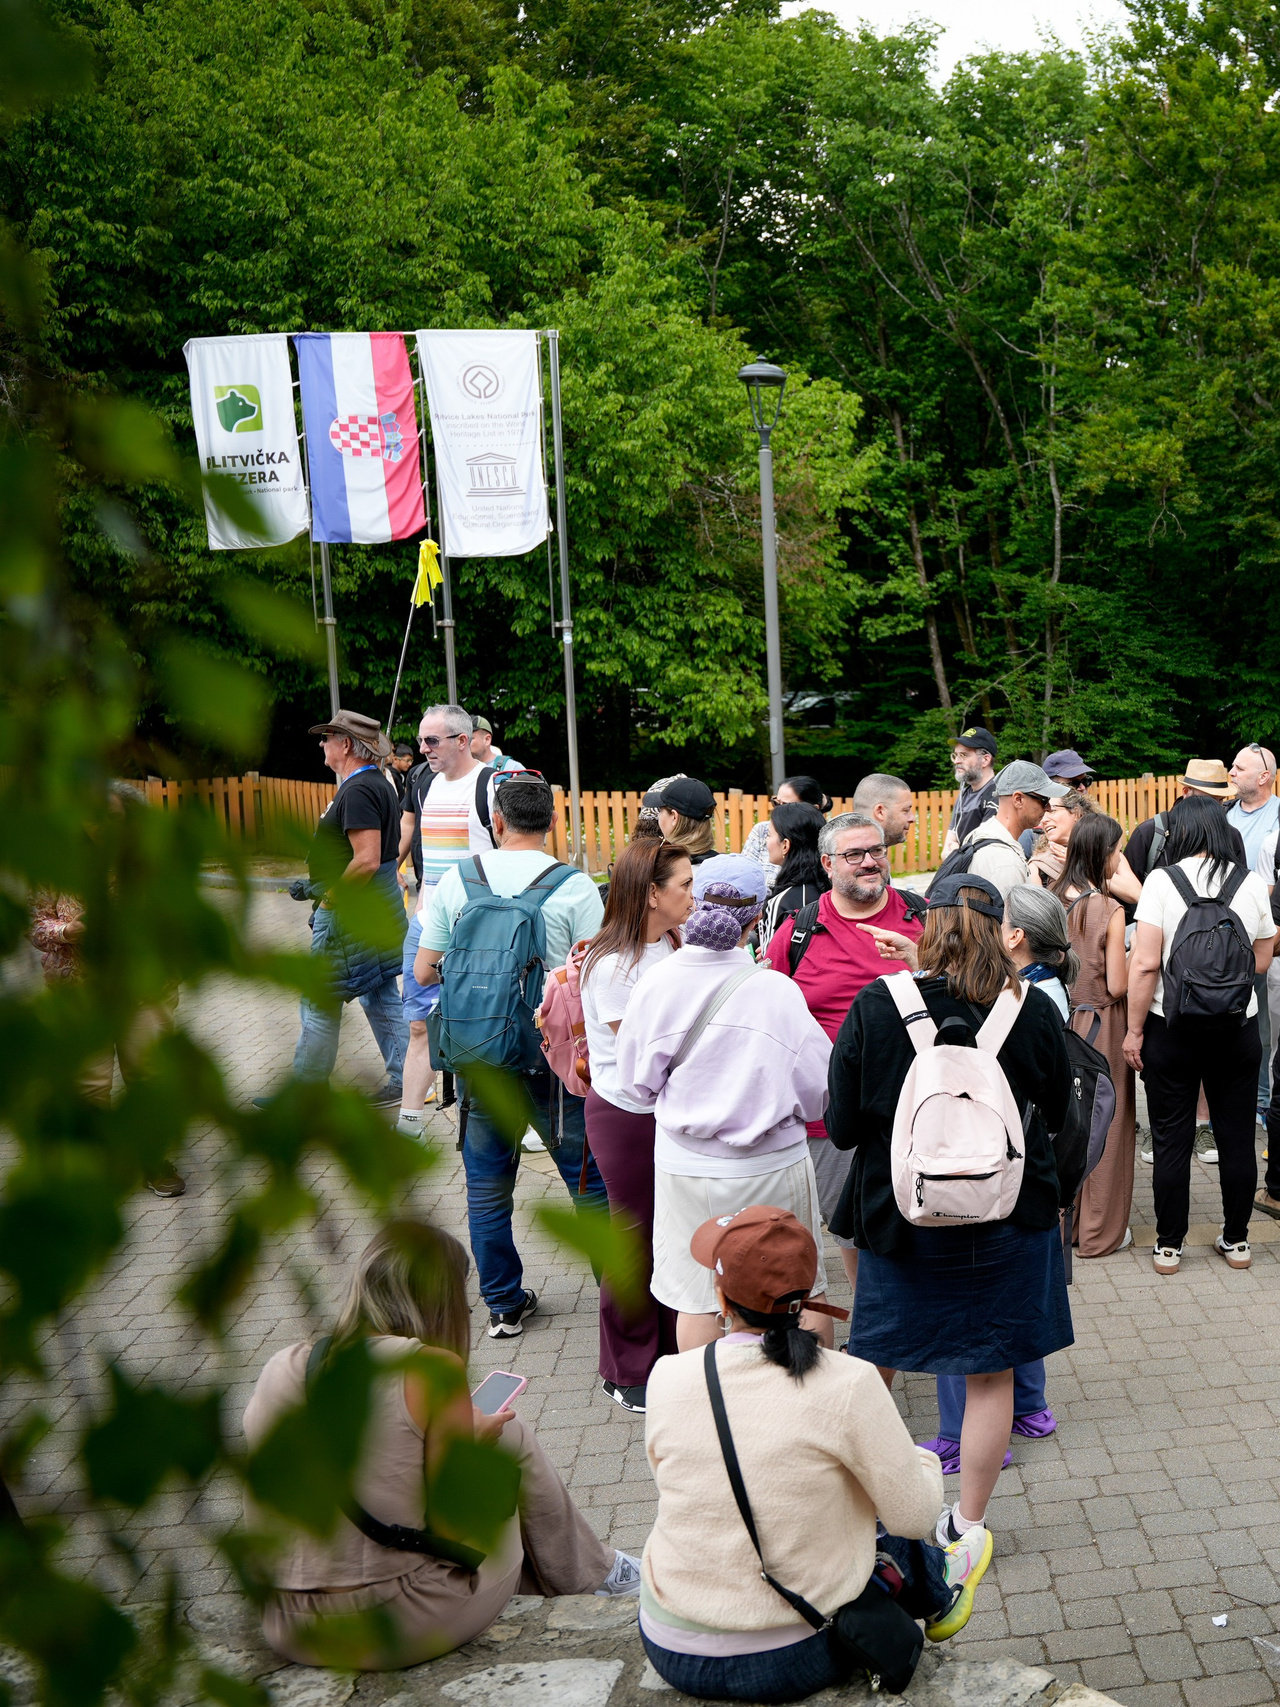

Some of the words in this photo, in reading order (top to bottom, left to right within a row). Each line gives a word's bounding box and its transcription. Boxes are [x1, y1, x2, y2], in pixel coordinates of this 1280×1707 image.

[487, 412, 519, 420] National
[469, 465, 517, 487] UNESCO
[256, 486, 281, 494] National
[931, 1211, 980, 1220] Champion
